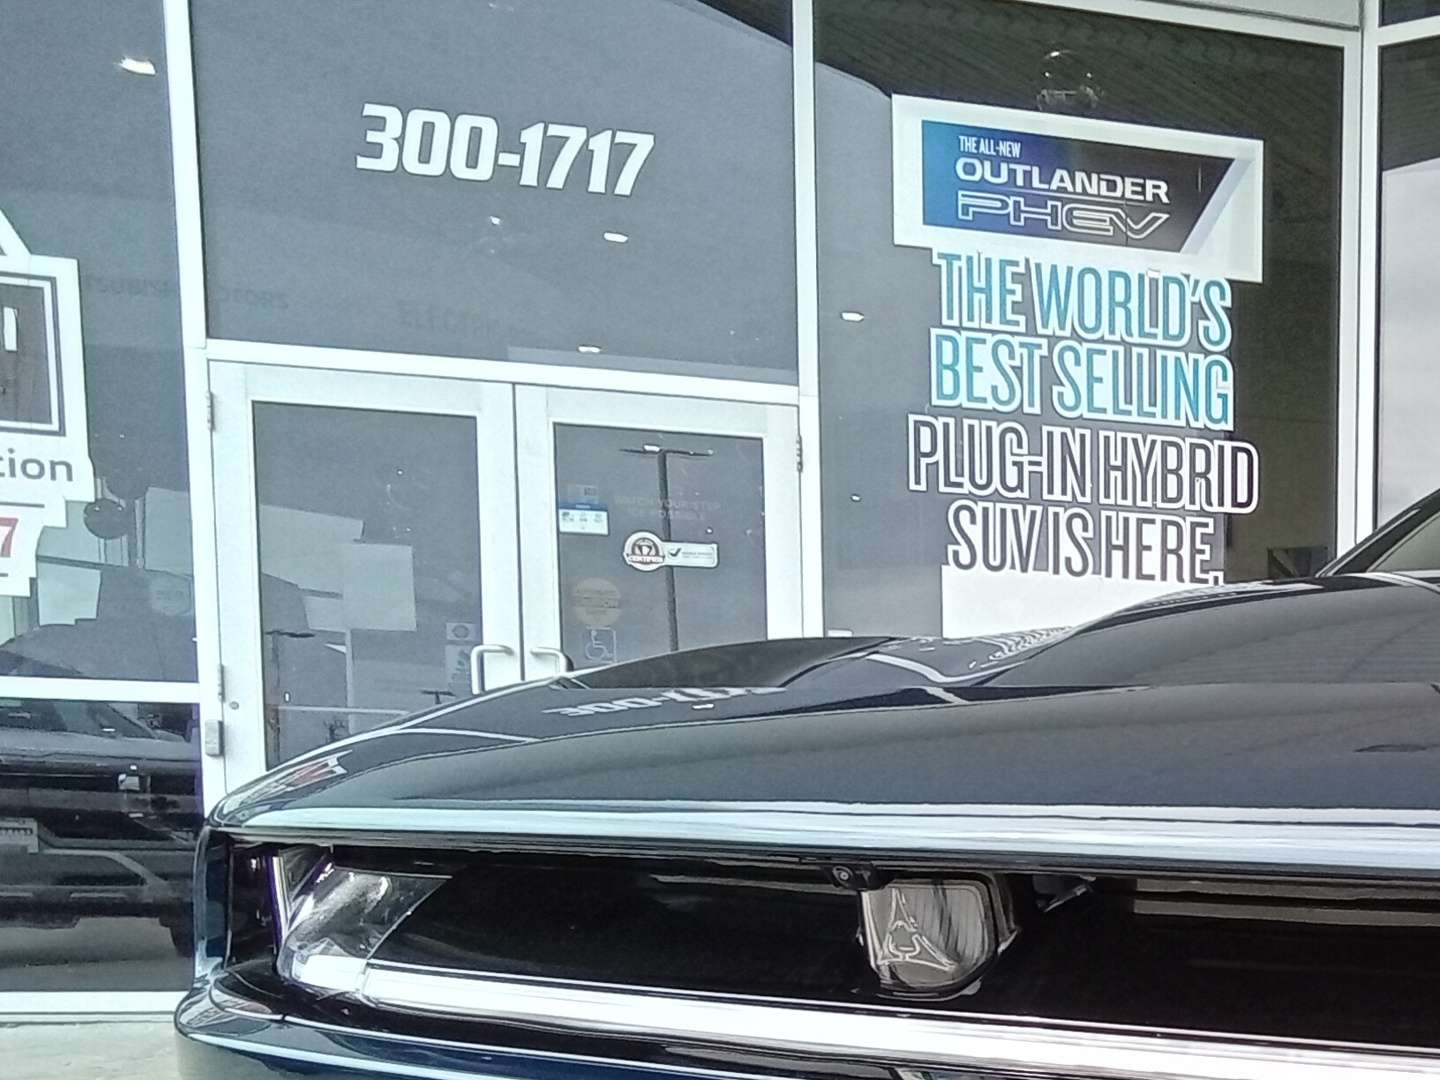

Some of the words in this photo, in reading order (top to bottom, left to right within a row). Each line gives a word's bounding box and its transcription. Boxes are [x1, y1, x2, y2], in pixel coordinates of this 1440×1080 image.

[355, 102, 656, 197] 300-1717
[955, 157, 1171, 204] OUTLANDER
[958, 135, 978, 154] THE
[979, 137, 1022, 158] ALL-NEW
[957, 190, 1171, 239] PHEV
[936, 252, 1022, 327] THE
[1033, 261, 1229, 348] WORLD'S
[934, 333, 1044, 411] BEST
[1056, 344, 1230, 426] SELLING
[912, 418, 1087, 498] PLUG-IN
[1103, 432, 1255, 509] HYBRID
[952, 503, 1039, 573] SUV
[1052, 507, 1090, 578] IS
